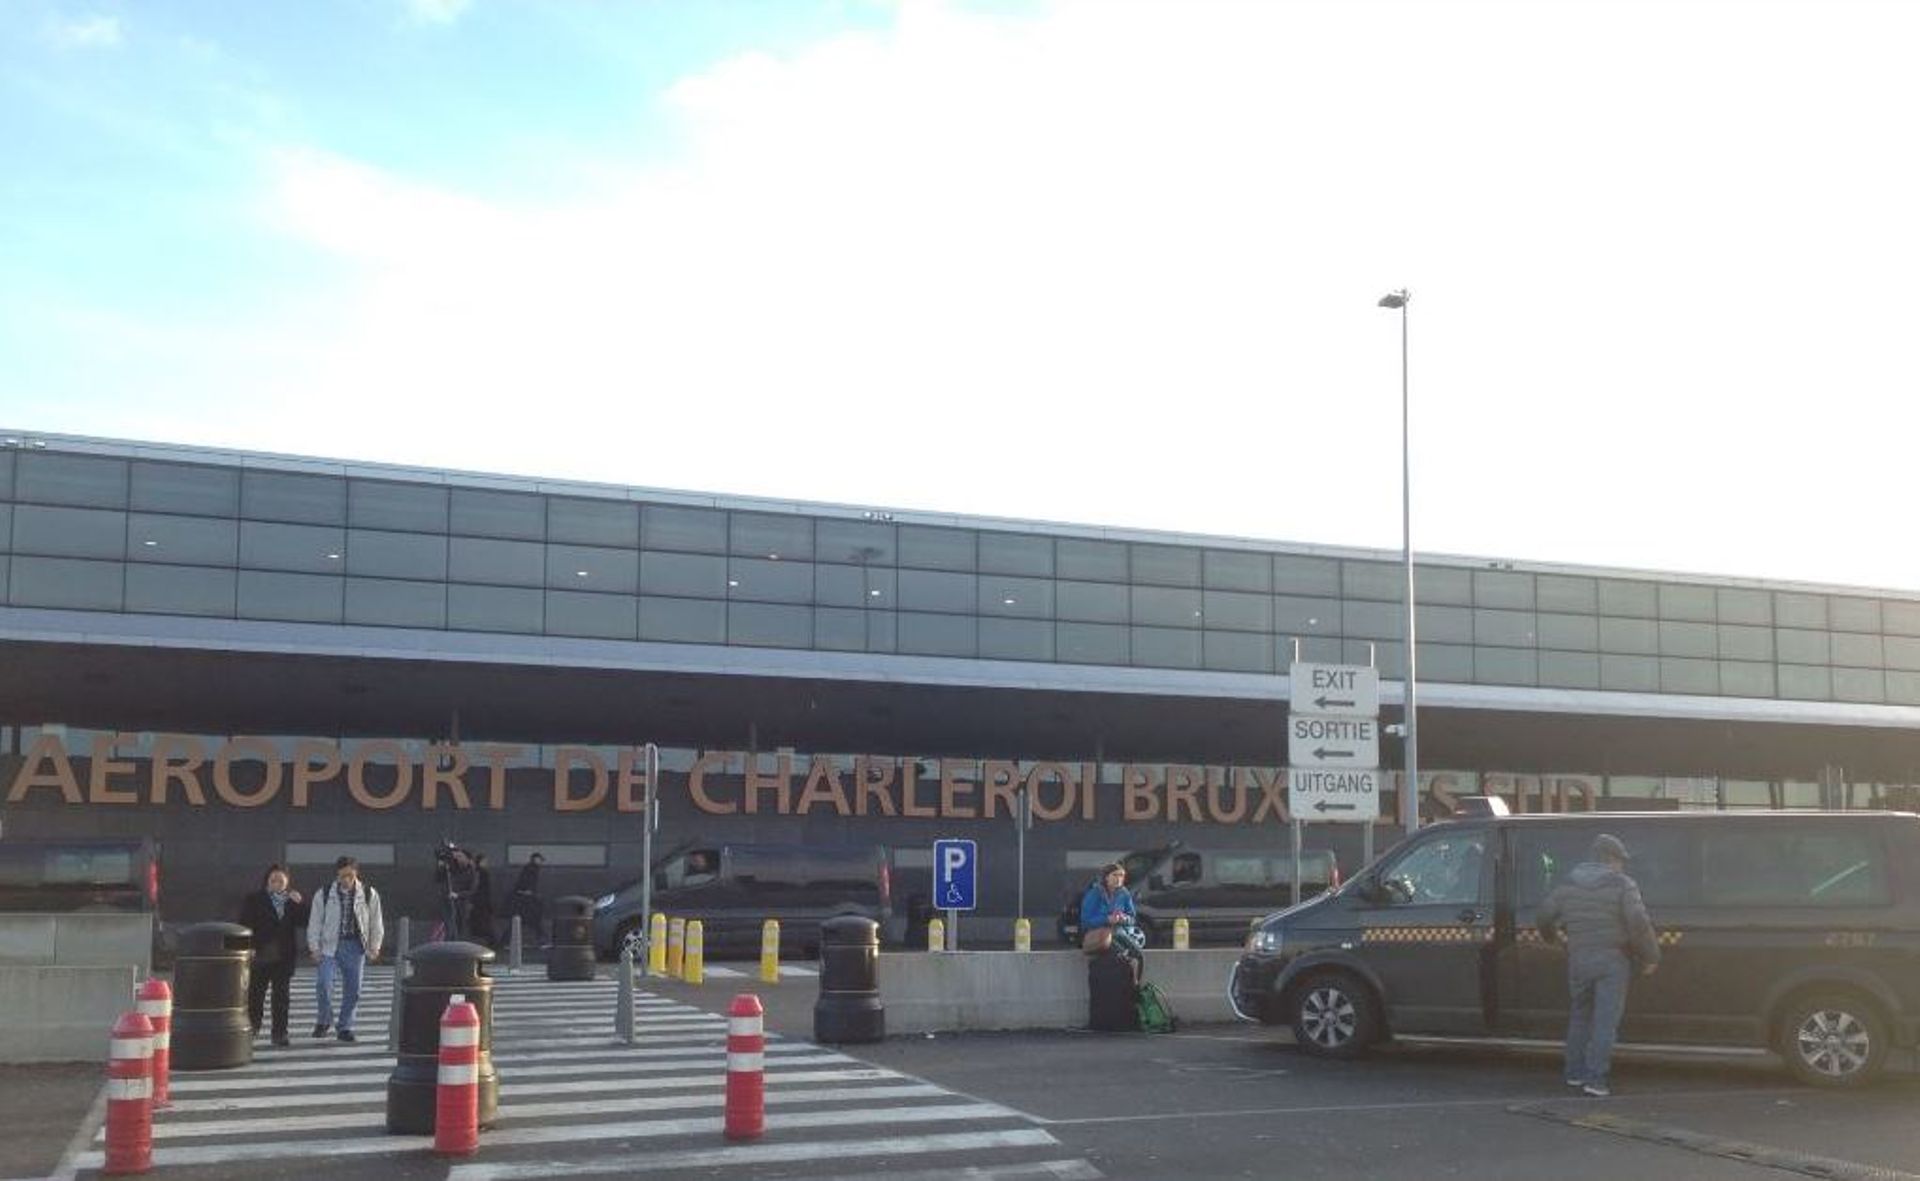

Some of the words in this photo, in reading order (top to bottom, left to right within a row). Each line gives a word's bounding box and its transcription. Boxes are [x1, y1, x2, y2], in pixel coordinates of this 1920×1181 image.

[1311, 669, 1357, 691] EXIT
[1295, 720, 1372, 742] SORTIE
[6, 732, 517, 809] AEROPORT
[555, 745, 652, 813] DE
[688, 752, 1095, 821] CHARLEROI
[1295, 772, 1372, 794] UITGANG
[944, 847, 967, 882] P
